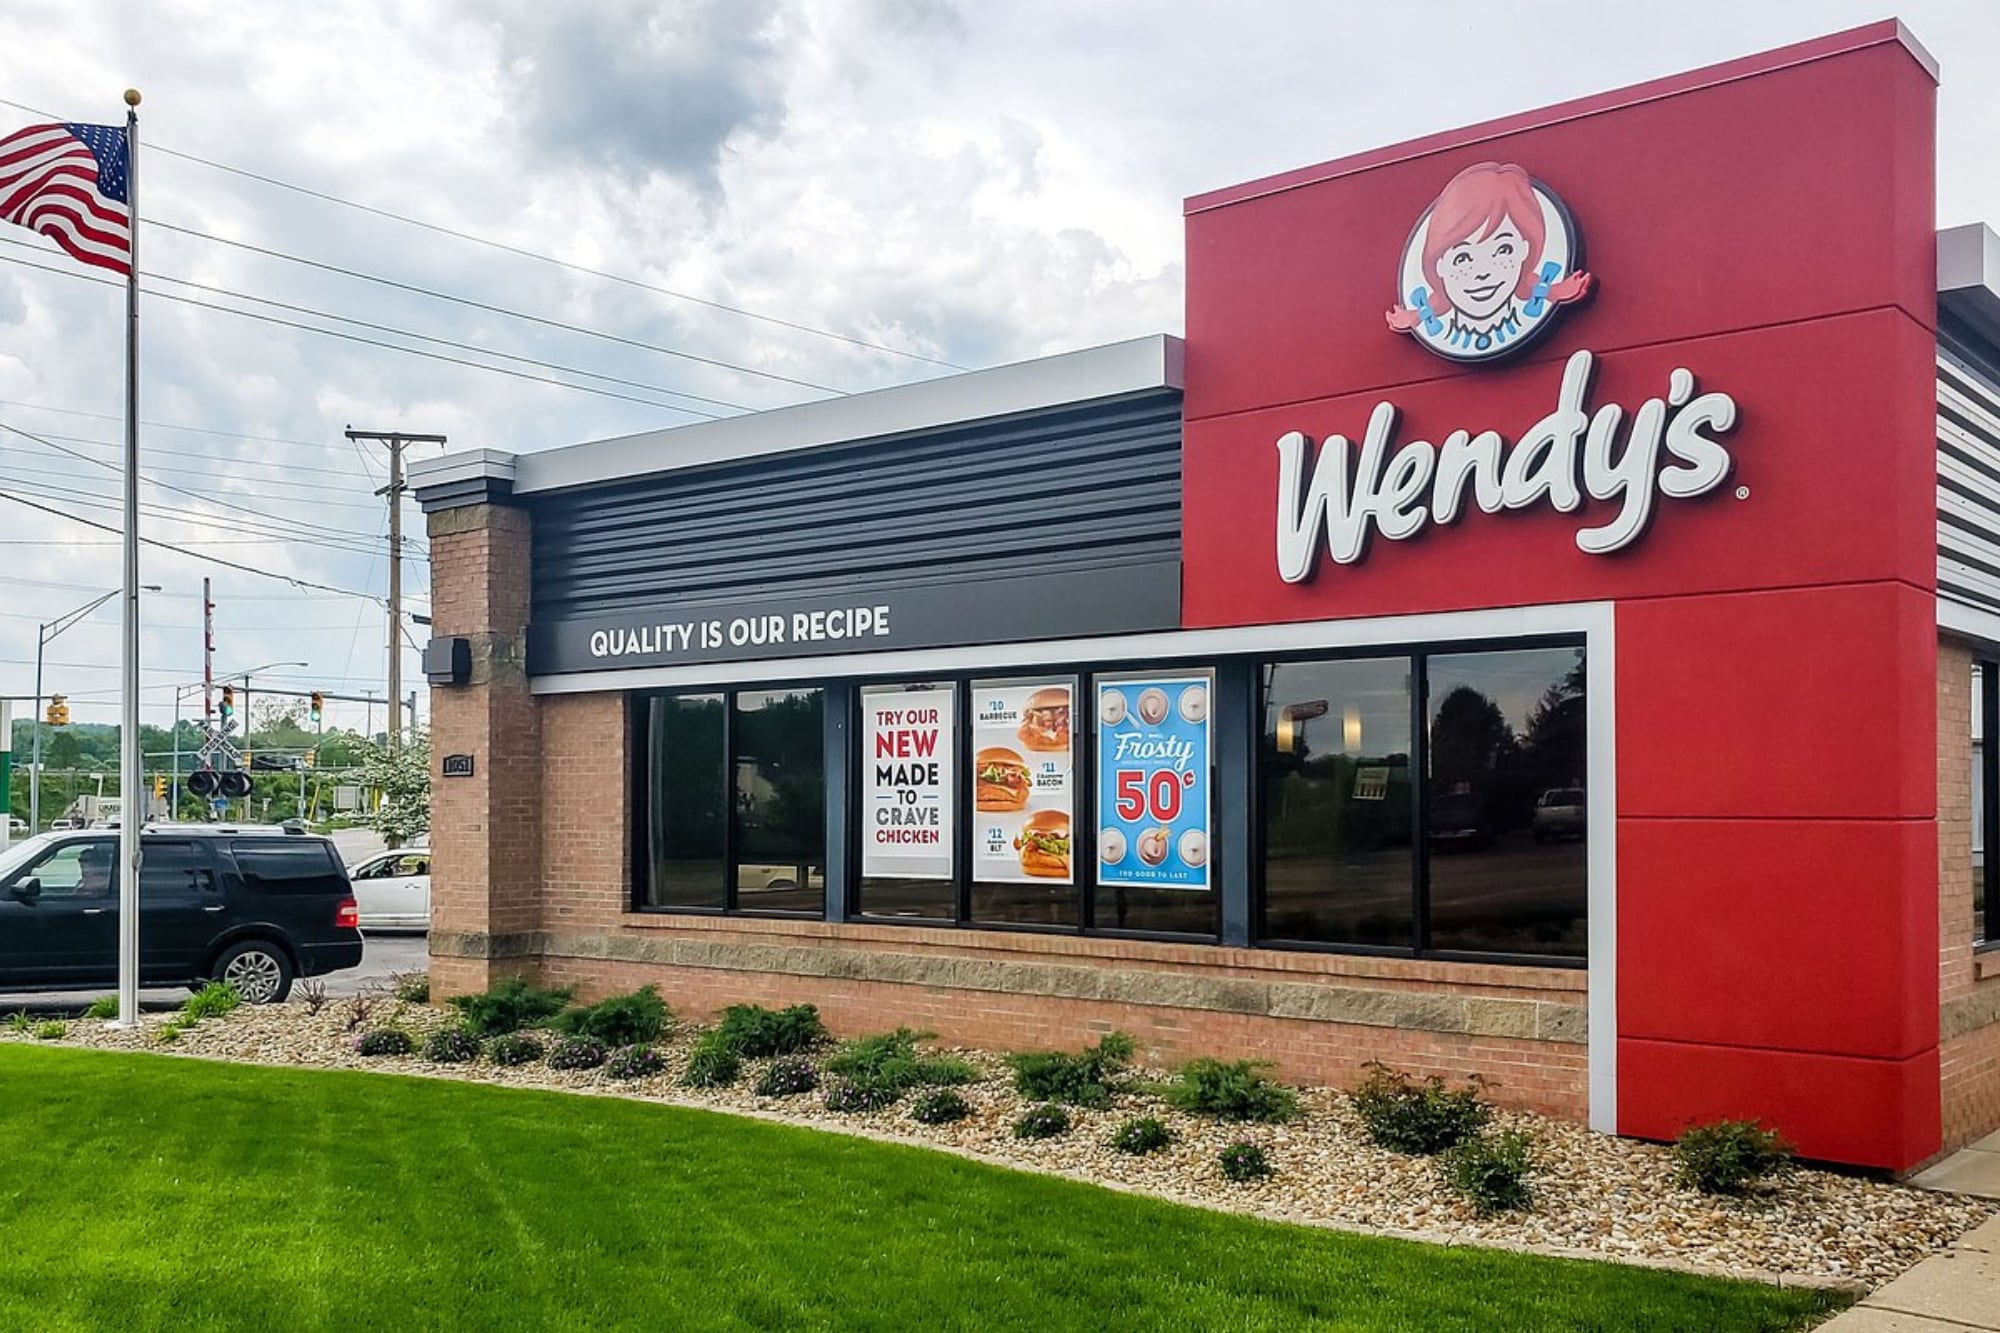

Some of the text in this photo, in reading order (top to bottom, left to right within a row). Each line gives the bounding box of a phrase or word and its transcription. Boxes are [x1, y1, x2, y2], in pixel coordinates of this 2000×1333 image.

[1277, 349, 1736, 584] Wendy's
[590, 605, 890, 657] QUALITY IS OUR RECIPE
[876, 708, 939, 726] TRY OUR
[876, 728, 939, 759] NEW
[1113, 732, 1196, 771] Frosty
[876, 763, 939, 787] MADE
[896, 789, 918, 805] TO
[876, 807, 939, 826] CRAVE
[876, 829, 939, 844] CHICKEN
